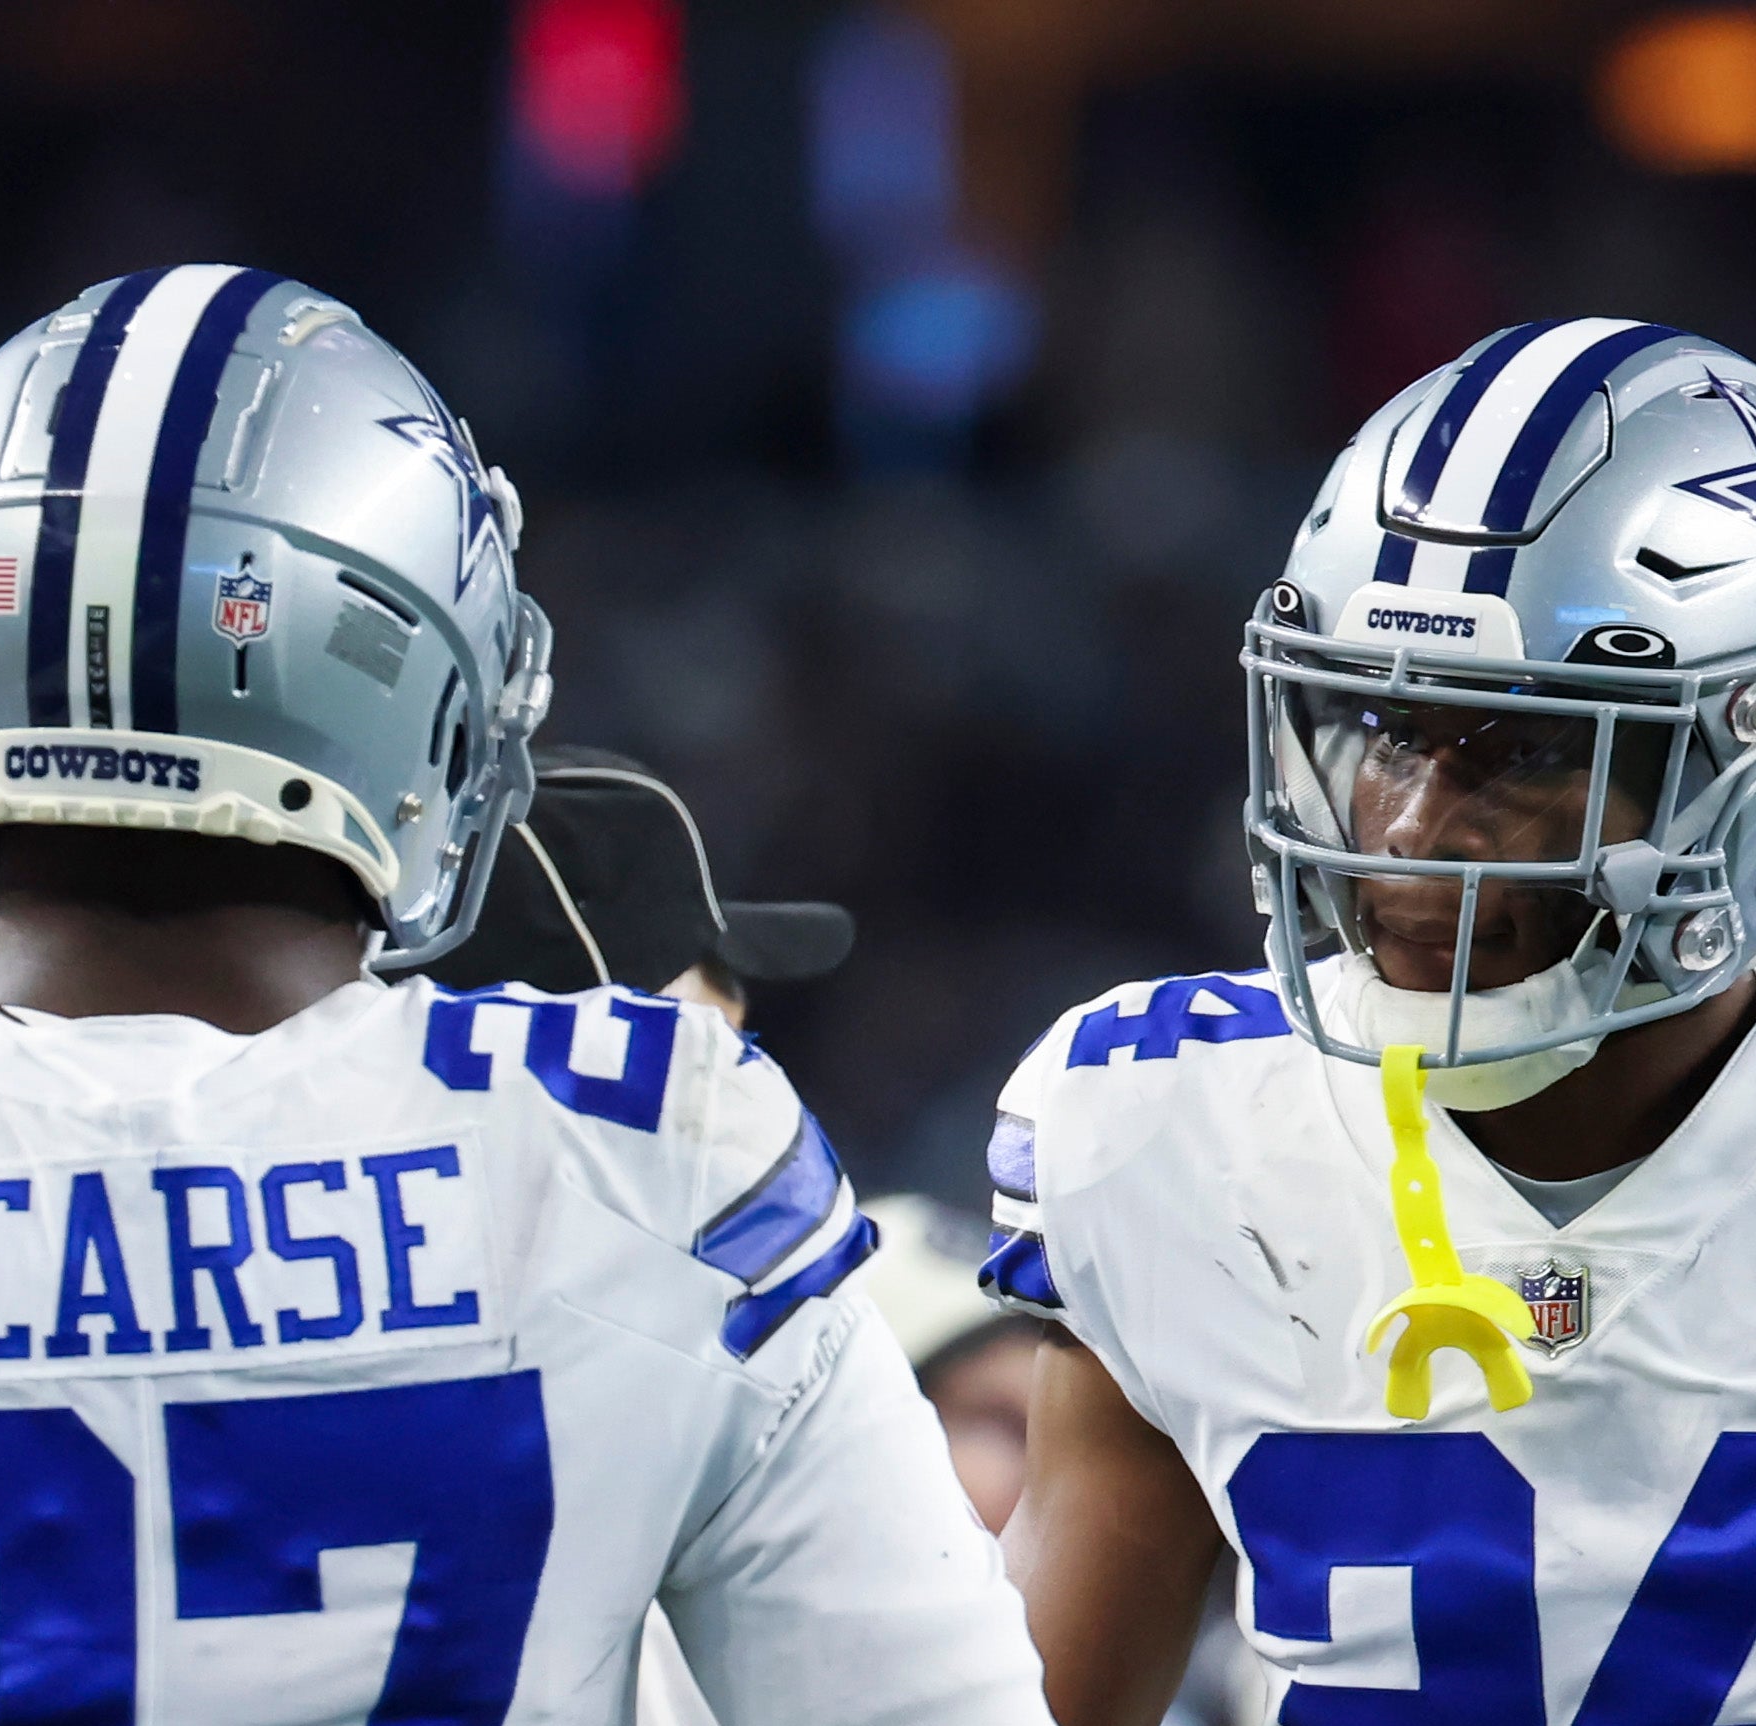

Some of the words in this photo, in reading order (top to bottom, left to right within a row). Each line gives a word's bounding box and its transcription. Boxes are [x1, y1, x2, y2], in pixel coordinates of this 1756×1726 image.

[219, 599, 264, 634] NFL
[1367, 607, 1477, 638] COWBOYS
[5, 744, 201, 792] COWBOYS
